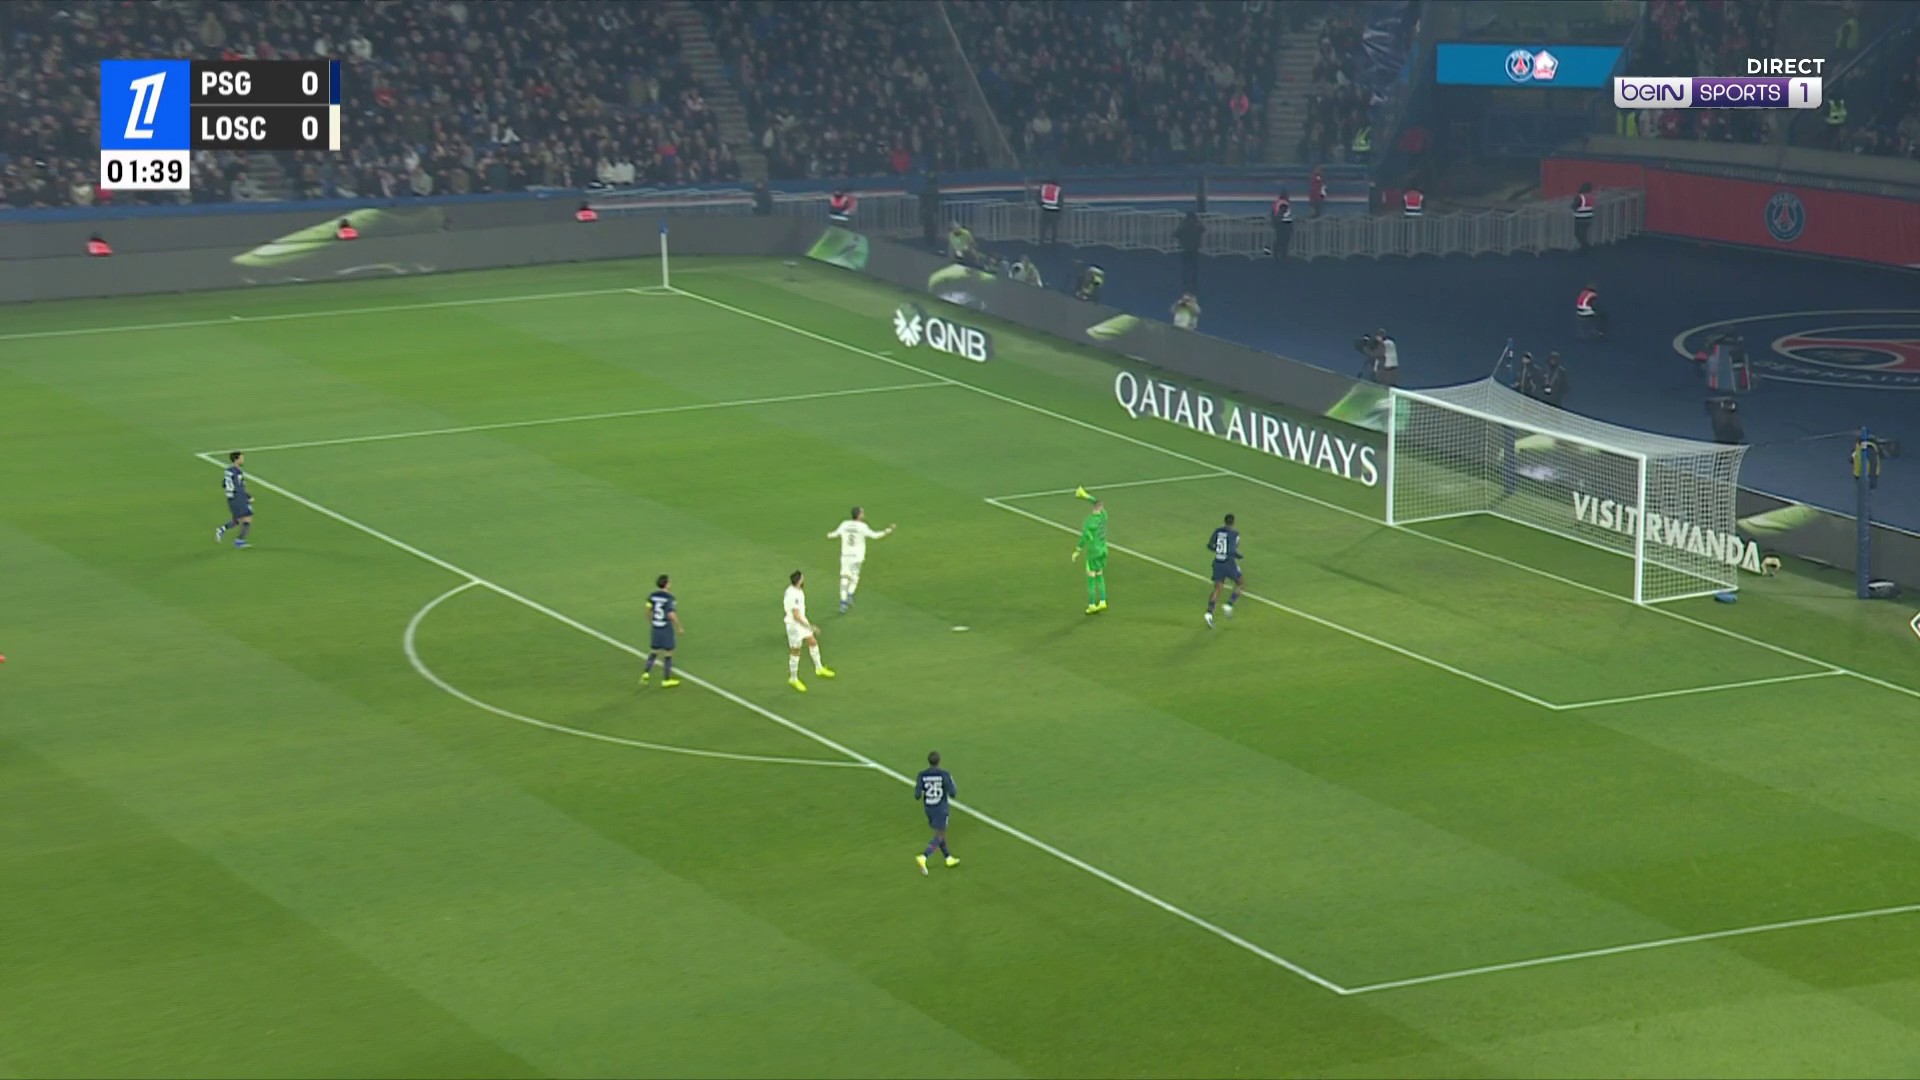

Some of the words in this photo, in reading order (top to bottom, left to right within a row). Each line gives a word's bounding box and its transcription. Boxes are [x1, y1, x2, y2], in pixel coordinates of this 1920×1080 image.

[925, 317, 987, 363] QNB
[1115, 371, 1216, 436] QATAR
[1226, 401, 1379, 487] AIRWAYS
[1573, 491, 1639, 536] VISIT
[1645, 512, 1762, 574] RWANDA
